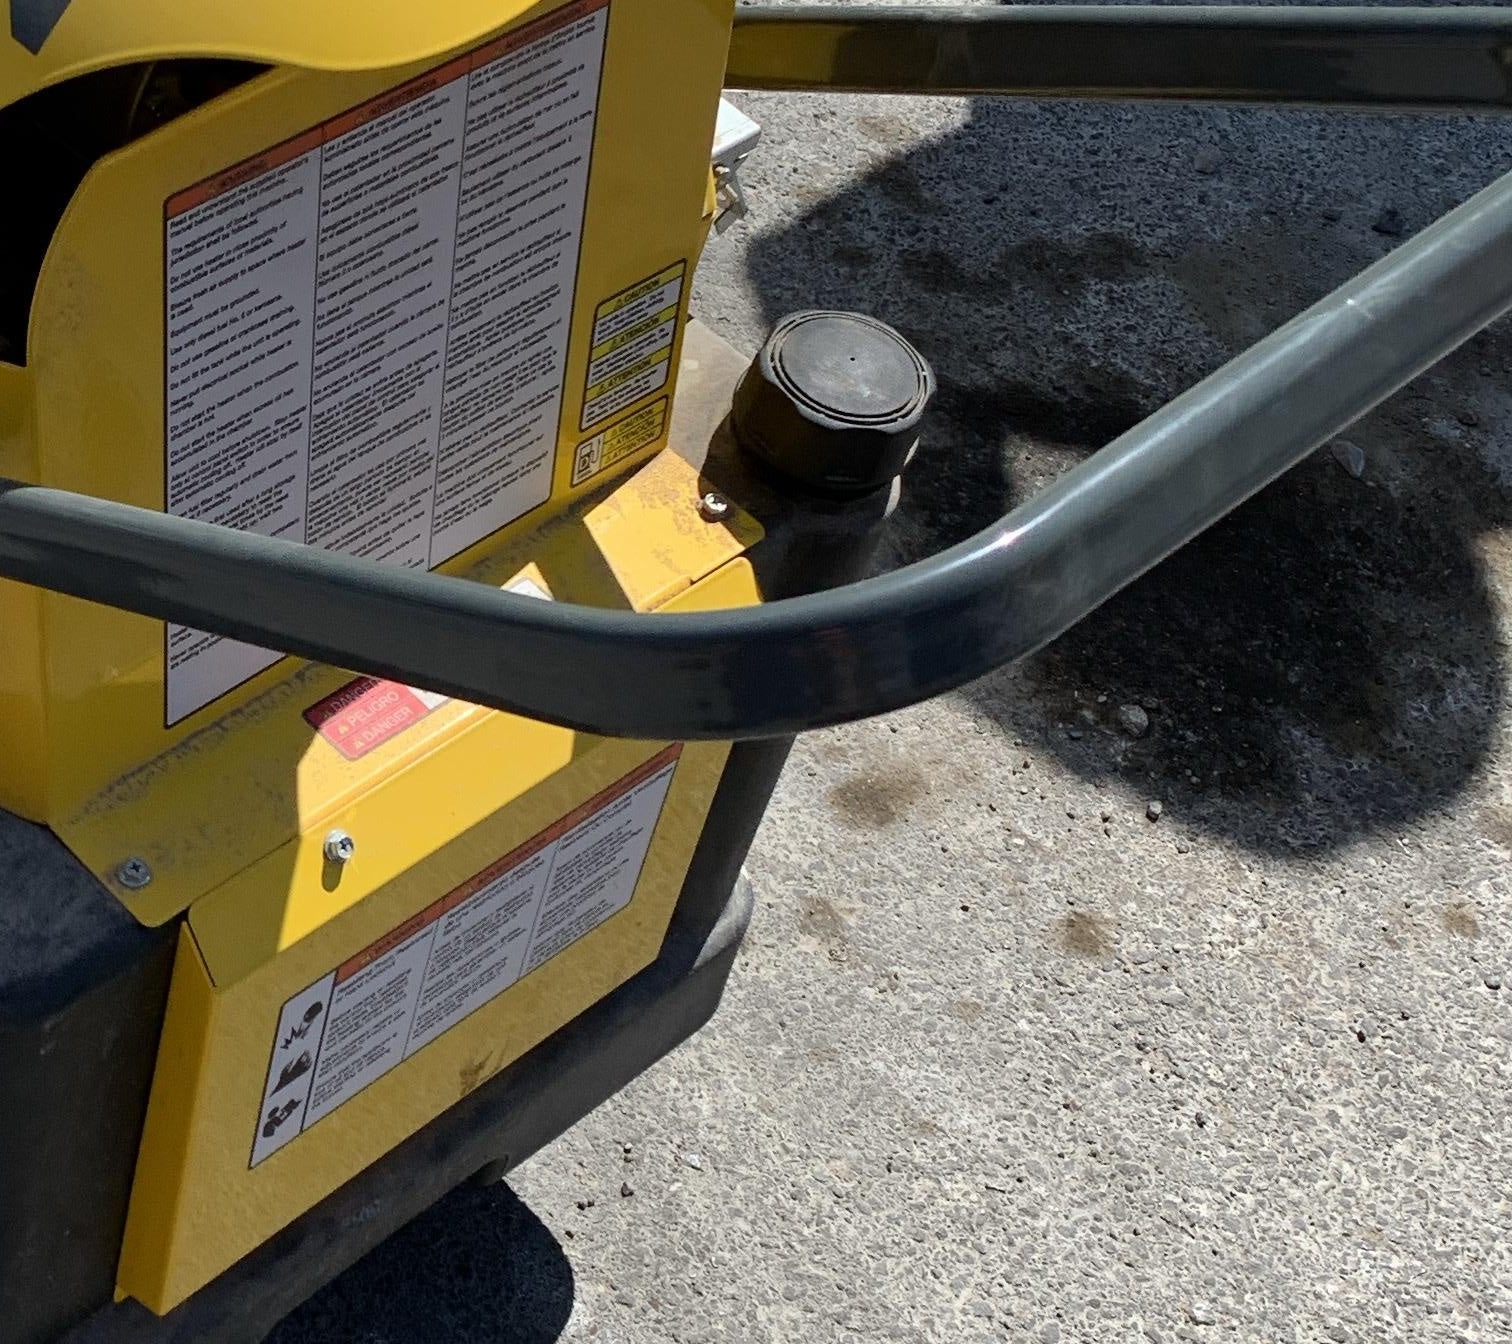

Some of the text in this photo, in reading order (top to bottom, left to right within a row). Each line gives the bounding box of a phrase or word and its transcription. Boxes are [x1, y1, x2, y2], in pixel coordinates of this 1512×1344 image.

[623, 277, 662, 304] CAUTION
[348, 690, 401, 727] PELIGRO
[364, 705, 414, 741] DANGER
